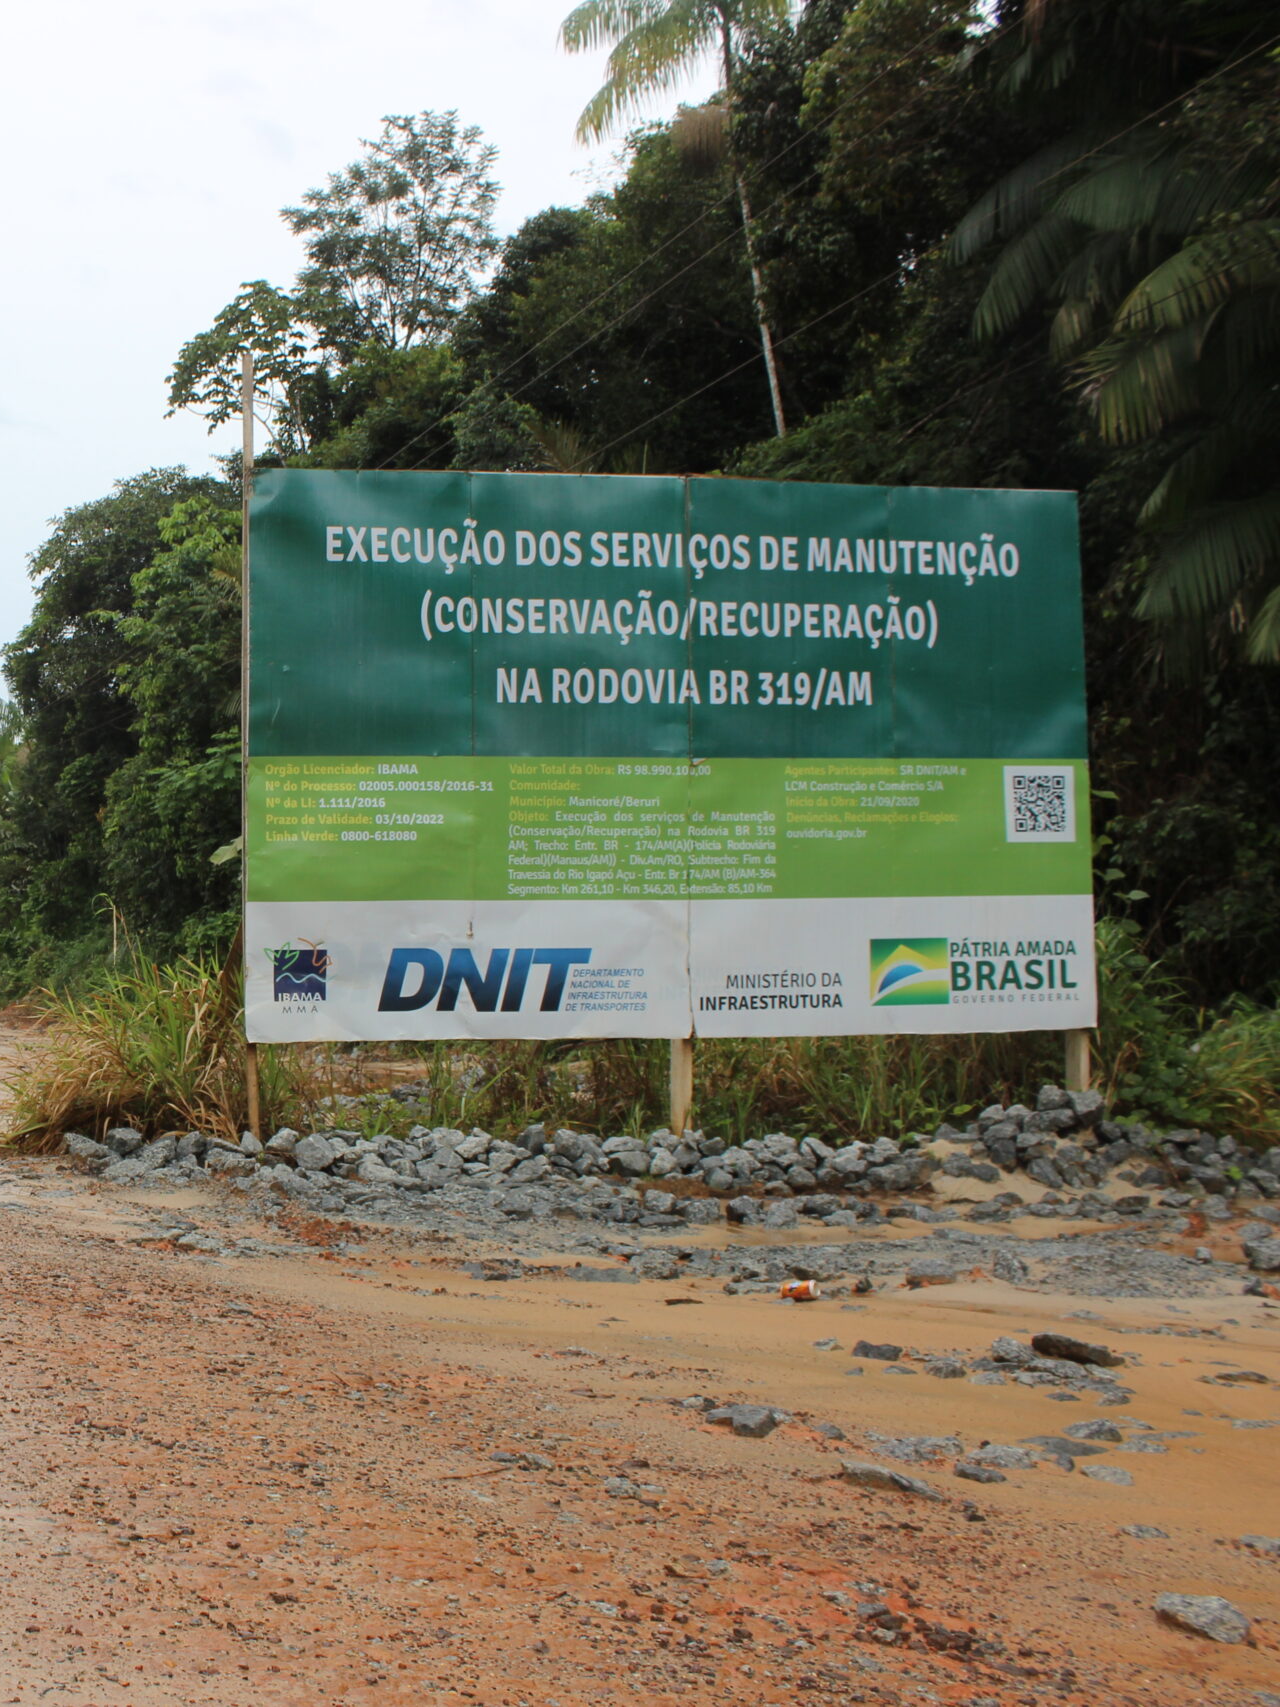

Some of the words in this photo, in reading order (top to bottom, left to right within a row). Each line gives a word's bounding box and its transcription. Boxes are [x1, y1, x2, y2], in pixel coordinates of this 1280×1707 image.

[326, 519, 506, 574] EXECUÇÃO
[515, 530, 582, 567] DOS
[590, 532, 751, 579] SERVIÇOS
[759, 536, 799, 571] DE
[807, 533, 1020, 586] MANUTENÇÃO
[421, 588, 938, 649] (CONSERVAÇÃO/RECUPERAÇÃO)
[496, 668, 542, 703] NA
[552, 668, 700, 704] RODOVIA
[709, 670, 749, 705] BR
[758, 668, 872, 710] 319/AM
[303, 764, 374, 775] Licenciador:
[377, 764, 418, 775] IBAMA
[510, 764, 537, 775] Valor
[540, 764, 565, 775] Total
[569, 764, 582, 775] da
[585, 764, 614, 775] Obra:
[618, 764, 631, 775] R$
[785, 765, 825, 777] Agentes
[900, 766, 912, 776] SR
[916, 766, 958, 776] DNIT/AM
[283, 781, 297, 791] do
[301, 781, 356, 791] Processo:
[359, 780, 493, 792] 02005.000158/2016-31
[510, 780, 580, 790] Comunidade:
[785, 781, 806, 791] LCM
[810, 781, 866, 793] Construção
[870, 783, 875, 791] e
[878, 781, 924, 791] Comércio
[927, 781, 944, 791] S/A
[283, 798, 297, 808] da
[301, 798, 316, 808] LI:
[319, 797, 385, 809] 1.111/2016
[510, 796, 566, 807] Município:
[569, 796, 660, 807] Manicoré/Beruri
[816, 797, 829, 807] da
[831, 797, 858, 807] Obra:
[860, 797, 920, 807] 21/09/2020
[266, 815, 298, 825] Prazo
[301, 814, 315, 825] de
[317, 814, 372, 825] Validade:
[375, 814, 444, 826] 03/10/2022
[509, 811, 549, 824] Objeto:
[555, 811, 607, 824] Execução
[613, 811, 633, 821] dos
[640, 811, 685, 824] serviços
[692, 811, 705, 821] de
[711, 811, 775, 824] Manutenção
[266, 831, 298, 841] Linha
[301, 831, 338, 841] Verde:
[341, 831, 417, 841] 0800-618080
[509, 824, 660, 838] (Conservação/Recuperação)
[667, 828, 680, 836] na
[688, 826, 728, 836] Rodovia
[735, 826, 750, 836] BR
[757, 826, 776, 836] 319
[787, 827, 867, 840] ouvidoria.gov.br
[534, 840, 568, 850] Trecho:
[575, 840, 597, 850] Entr.
[604, 840, 618, 850] BR
[688, 854, 738, 865] Subtrecho:
[743, 854, 761, 864] Fim
[765, 854, 776, 864] da
[508, 869, 550, 879] Travessia
[553, 869, 565, 879] do
[568, 869, 583, 879] Rio
[644, 869, 666, 879] Entr.
[668, 869, 679, 879] Br
[508, 884, 559, 896] Segmento:
[562, 884, 578, 894] Km
[623, 884, 640, 894] Km
[757, 883, 773, 893] Km
[949, 941, 1010, 957] PÁTRIA
[1014, 940, 1077, 956] AMADA
[572, 968, 644, 977] DEPARTAMENTO
[950, 959, 1078, 992] BRASIL
[377, 948, 592, 1012] DNIT
[570, 980, 615, 989] NACIONAL
[618, 980, 631, 989] DE
[726, 970, 817, 989] MINISTÉRIO
[821, 972, 843, 988] DA
[278, 991, 322, 1002] IBAMA
[567, 991, 648, 1000] INFRAESTRUTURA
[952, 994, 1015, 1005] GOVERNO
[1022, 993, 1080, 1003] FEDERAL
[565, 1002, 578, 1012] DE
[579, 1002, 647, 1012] TRANSPORTES
[699, 993, 843, 1011] INFRAESTRUTURA
